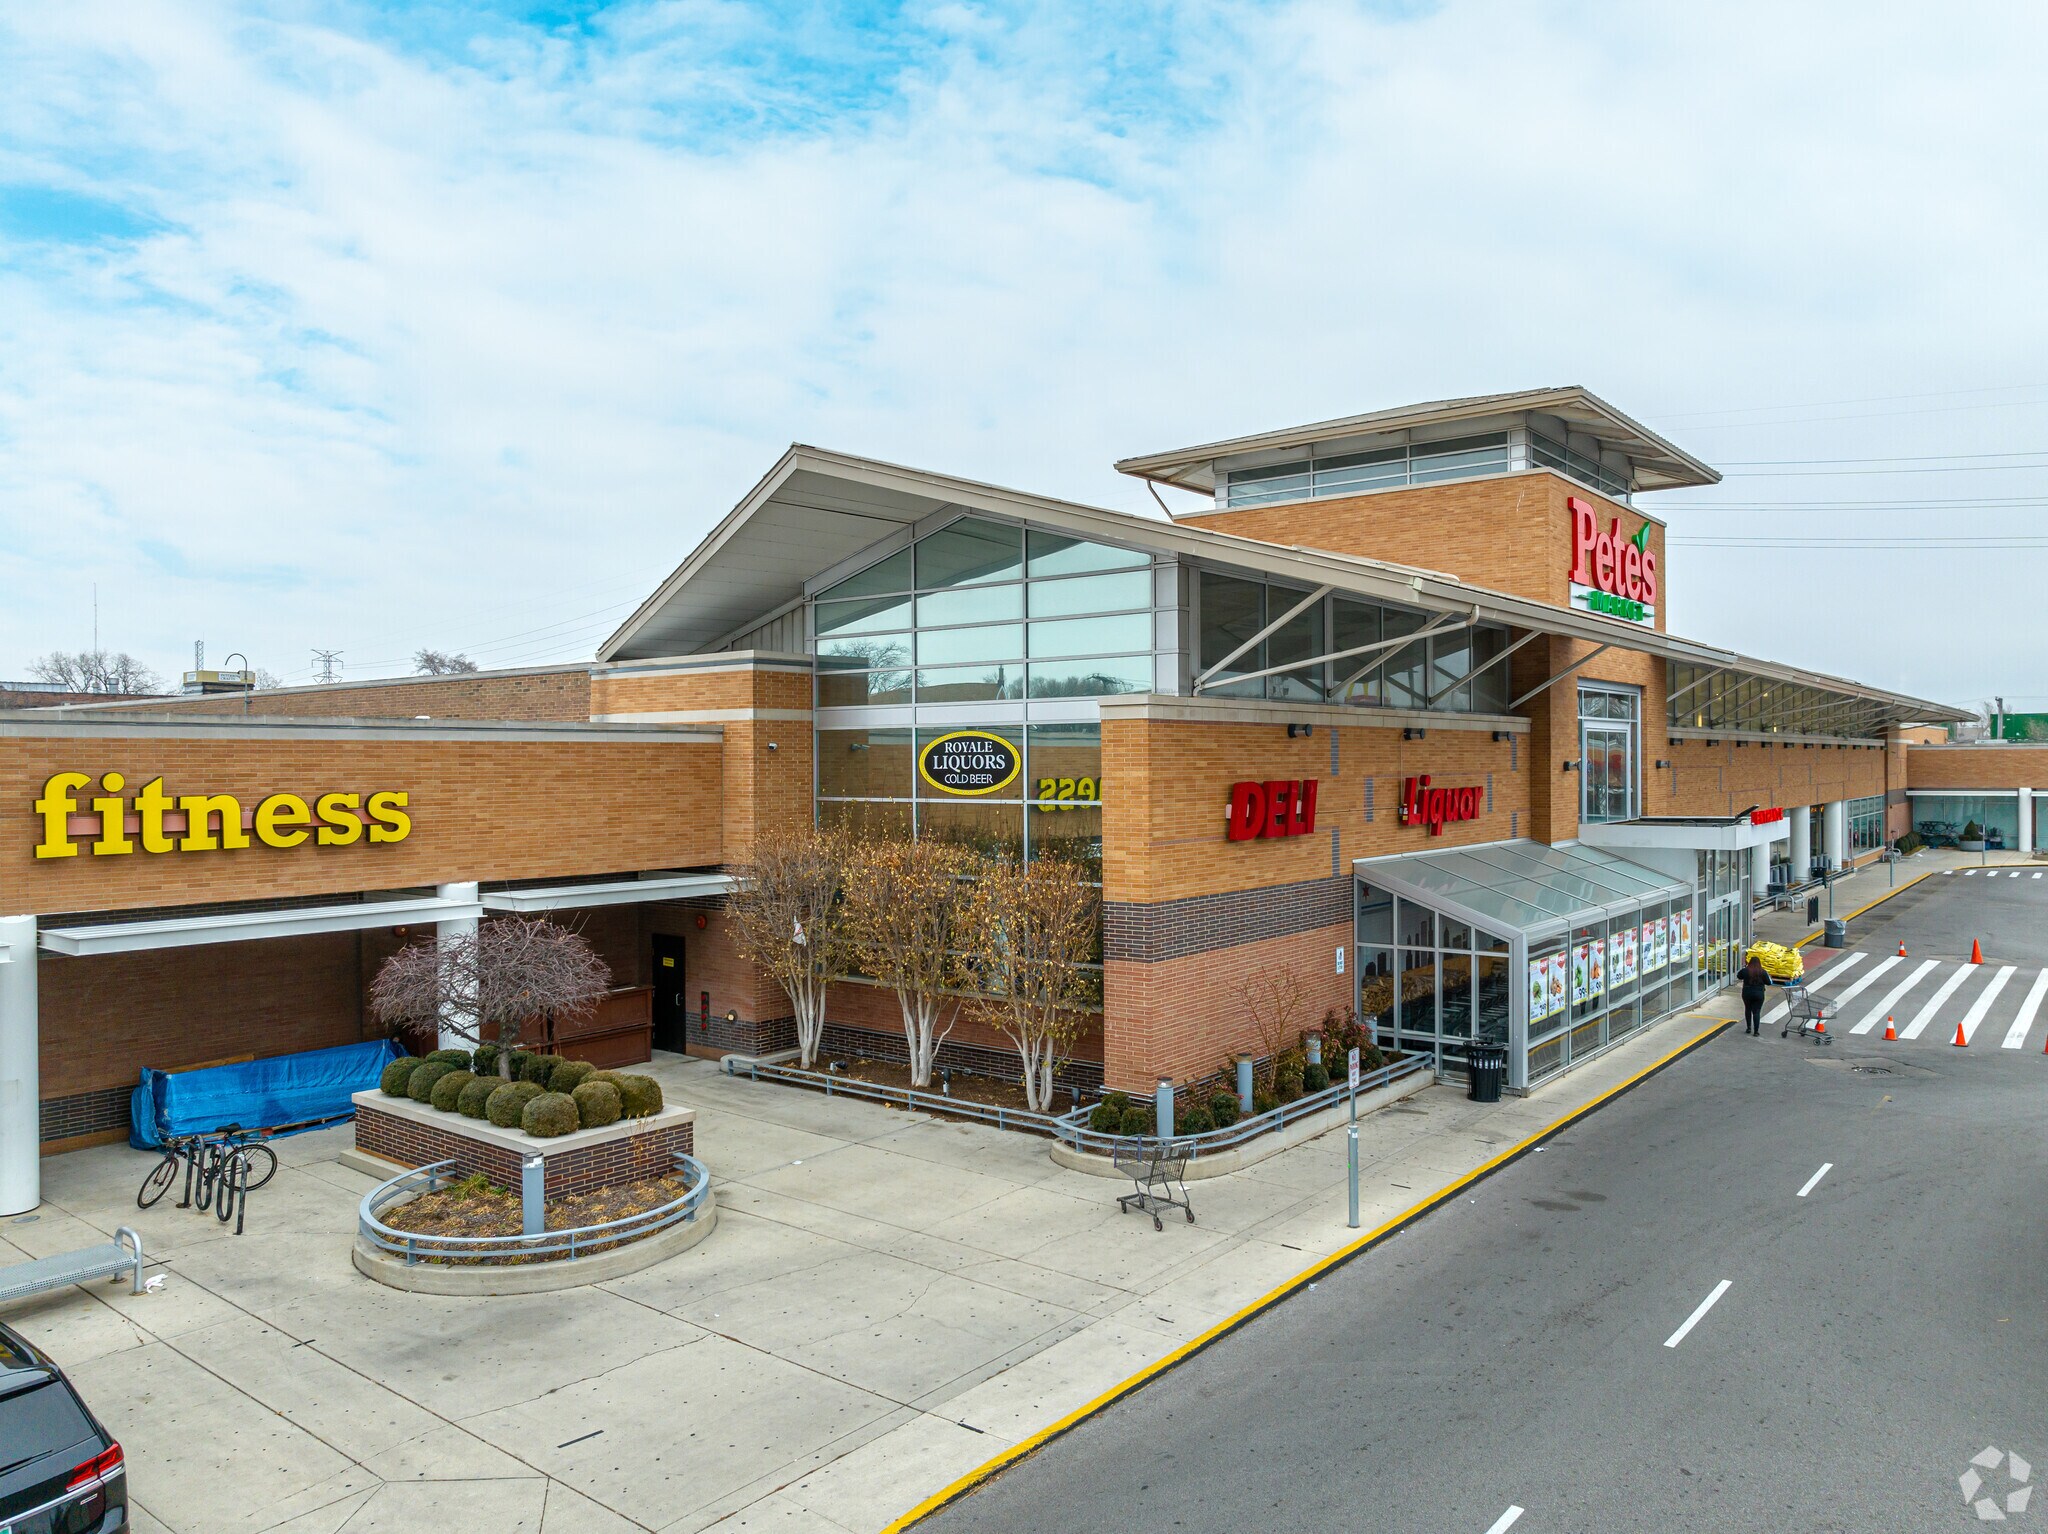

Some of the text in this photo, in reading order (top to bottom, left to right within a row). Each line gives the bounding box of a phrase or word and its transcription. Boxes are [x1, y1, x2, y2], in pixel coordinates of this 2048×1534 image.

[1589, 590, 1644, 622] MARKET
[944, 741, 993, 753] ROYALE
[933, 754, 1006, 773] LIQUORS
[944, 773, 994, 784] COLD BEER
[34, 772, 411, 859] fitness
[1229, 779, 1318, 841] DELI
[1402, 774, 1484, 836] Liquor
